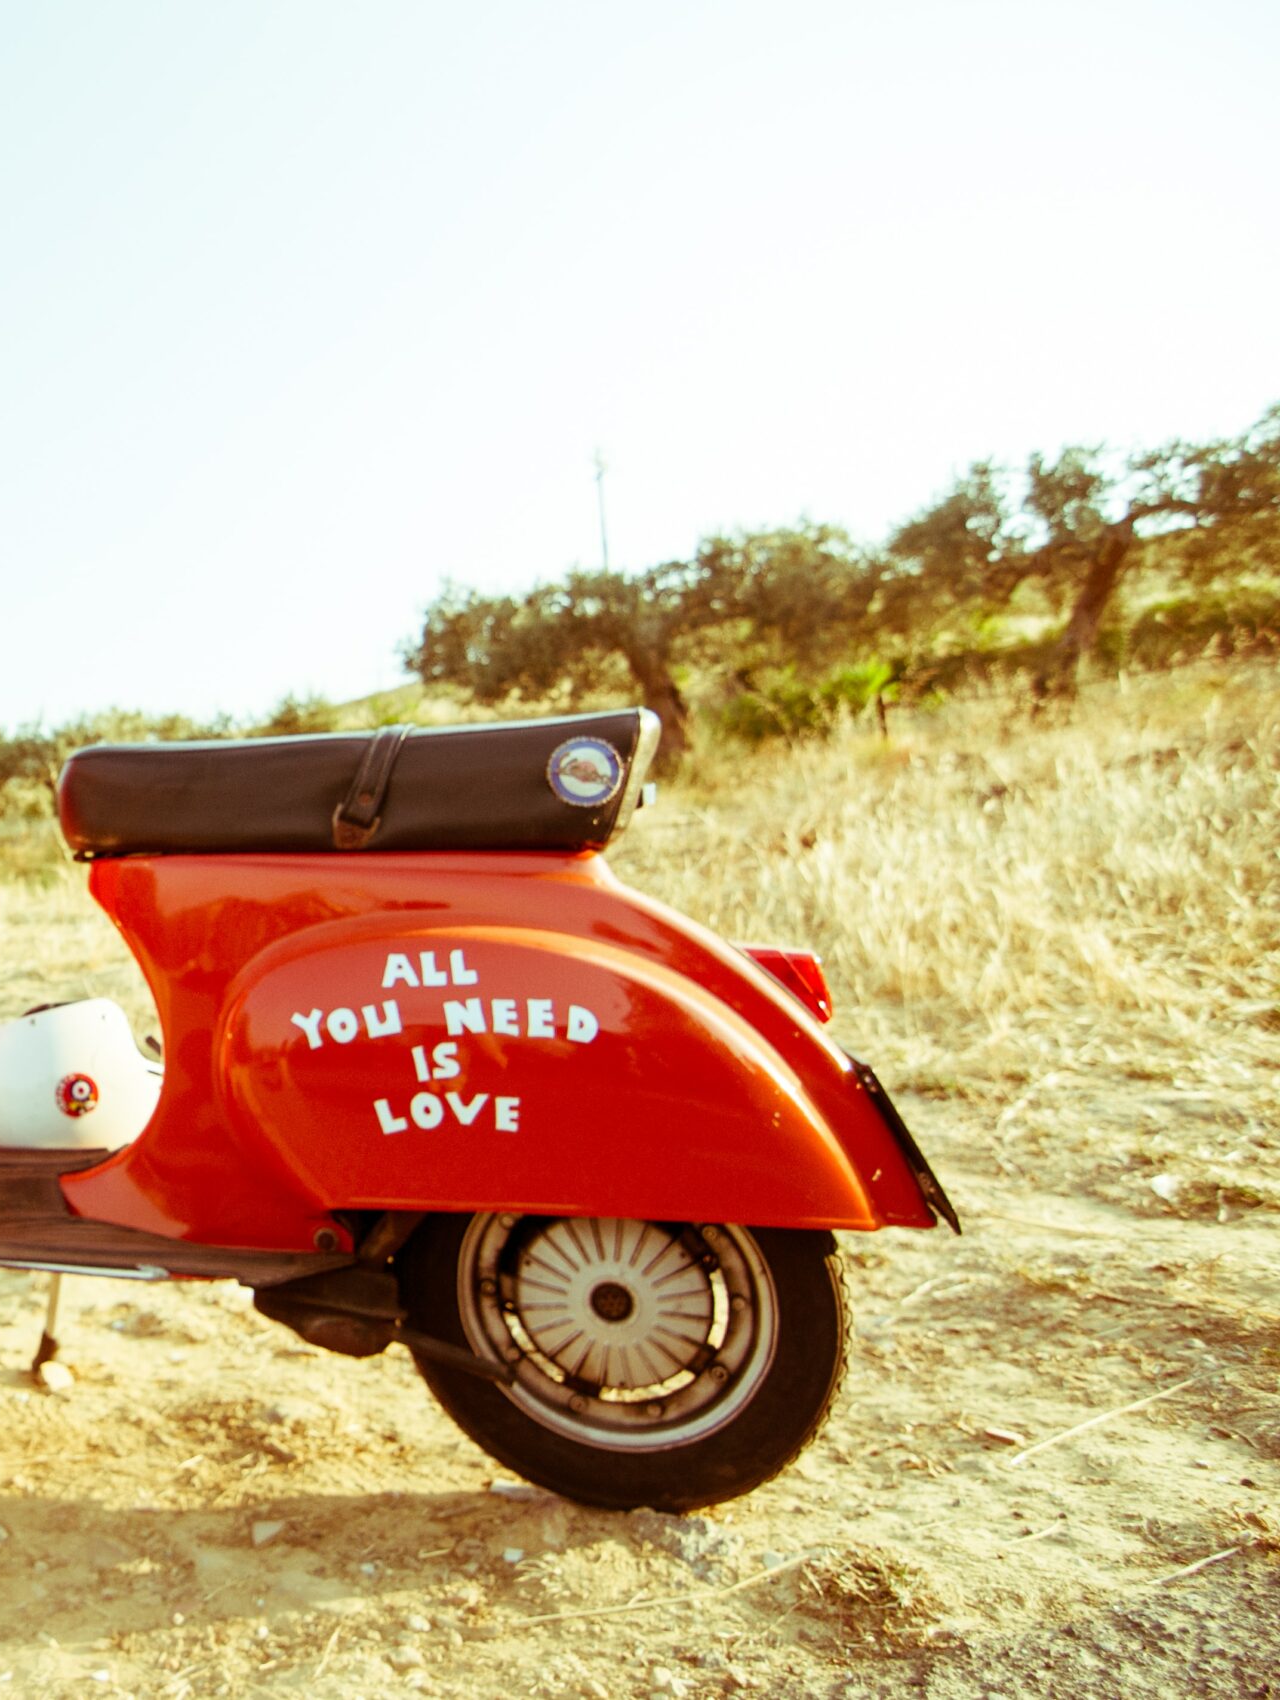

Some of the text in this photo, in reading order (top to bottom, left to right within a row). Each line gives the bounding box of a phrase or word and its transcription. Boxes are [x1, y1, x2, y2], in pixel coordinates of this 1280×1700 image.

[381, 949, 478, 988] ALL
[291, 998, 599, 1050] YOU NEED
[411, 1042, 461, 1082] IS
[374, 1091, 520, 1134] LOVE
